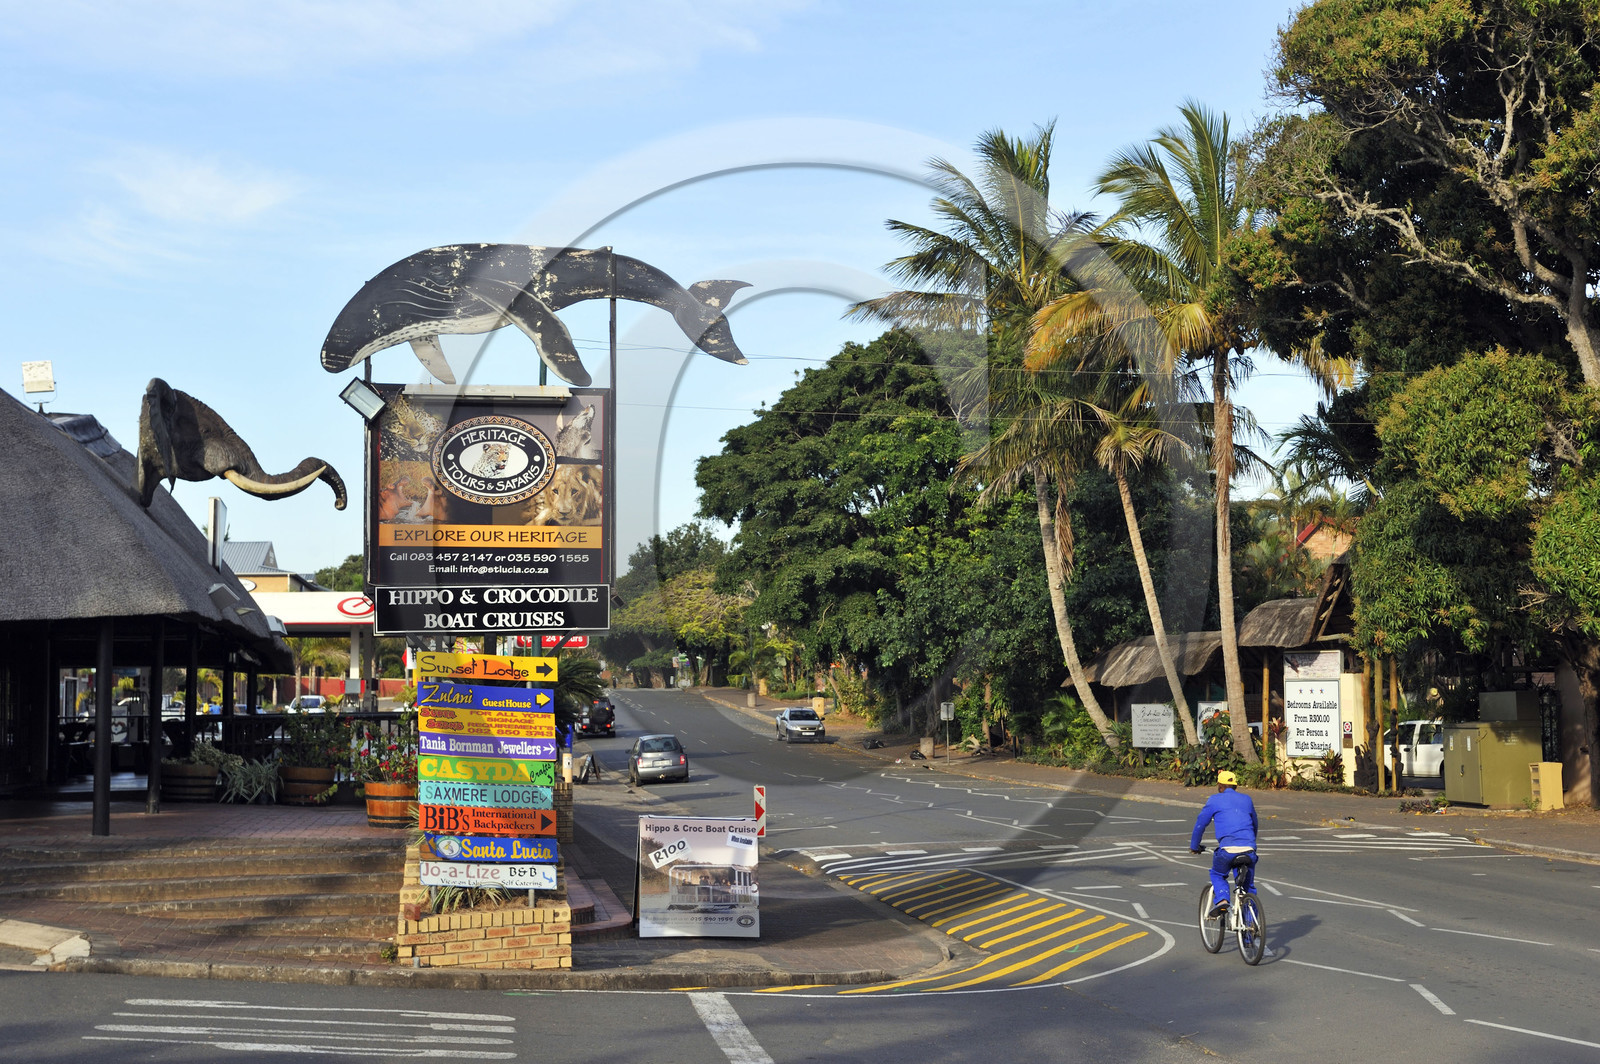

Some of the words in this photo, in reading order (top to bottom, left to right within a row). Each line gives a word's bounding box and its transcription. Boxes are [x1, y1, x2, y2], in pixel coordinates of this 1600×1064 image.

[460, 430, 526, 447] HERITAGE
[448, 462, 486, 490] TOURS
[486, 482, 494, 490] &
[496, 464, 540, 491] SAFARIS
[394, 530, 466, 541] EXPLORE
[470, 530, 504, 542] OUR
[508, 531, 588, 542] HERITAGE
[390, 552, 408, 561] Call
[410, 552, 434, 561] 083
[436, 553, 460, 561] 457
[462, 553, 493, 562] 2147
[507, 554, 531, 562] 035
[533, 554, 556, 562] 590
[559, 554, 589, 562] 1555
[428, 564, 458, 573] Email:
[460, 565, 549, 574] info@stlucia.co.za
[388, 589, 454, 605] HIPPO
[460, 589, 478, 604] &
[483, 588, 599, 604] CROCODILE
[424, 613, 478, 628] BOAT
[482, 611, 565, 628] CRUISES
[420, 655, 477, 674] Sunset
[482, 659, 529, 679] Lodge
[1287, 700, 1311, 708] Bedrooms
[1312, 700, 1337, 709] Available
[1294, 714, 1308, 722] From
[1296, 728, 1305, 736] Per
[1306, 728, 1324, 736] Person
[420, 736, 446, 751] Tania
[449, 738, 494, 754] Bornman
[498, 741, 541, 755] Jewellers
[1295, 741, 1309, 752] Night
[420, 758, 530, 781] CASYDA
[530, 763, 552, 784] Crafts
[425, 786, 487, 802] SAXMERE
[494, 790, 538, 804] LODGE
[424, 806, 470, 830] BiB's
[472, 809, 536, 819] International
[474, 820, 535, 831] Backpackers
[645, 824, 670, 833] Hippo
[461, 838, 506, 858] Santa
[510, 840, 553, 859] Lucia
[654, 840, 686, 863] R100
[423, 863, 500, 879] Jo-a-Lize
[509, 867, 537, 878] B&B
